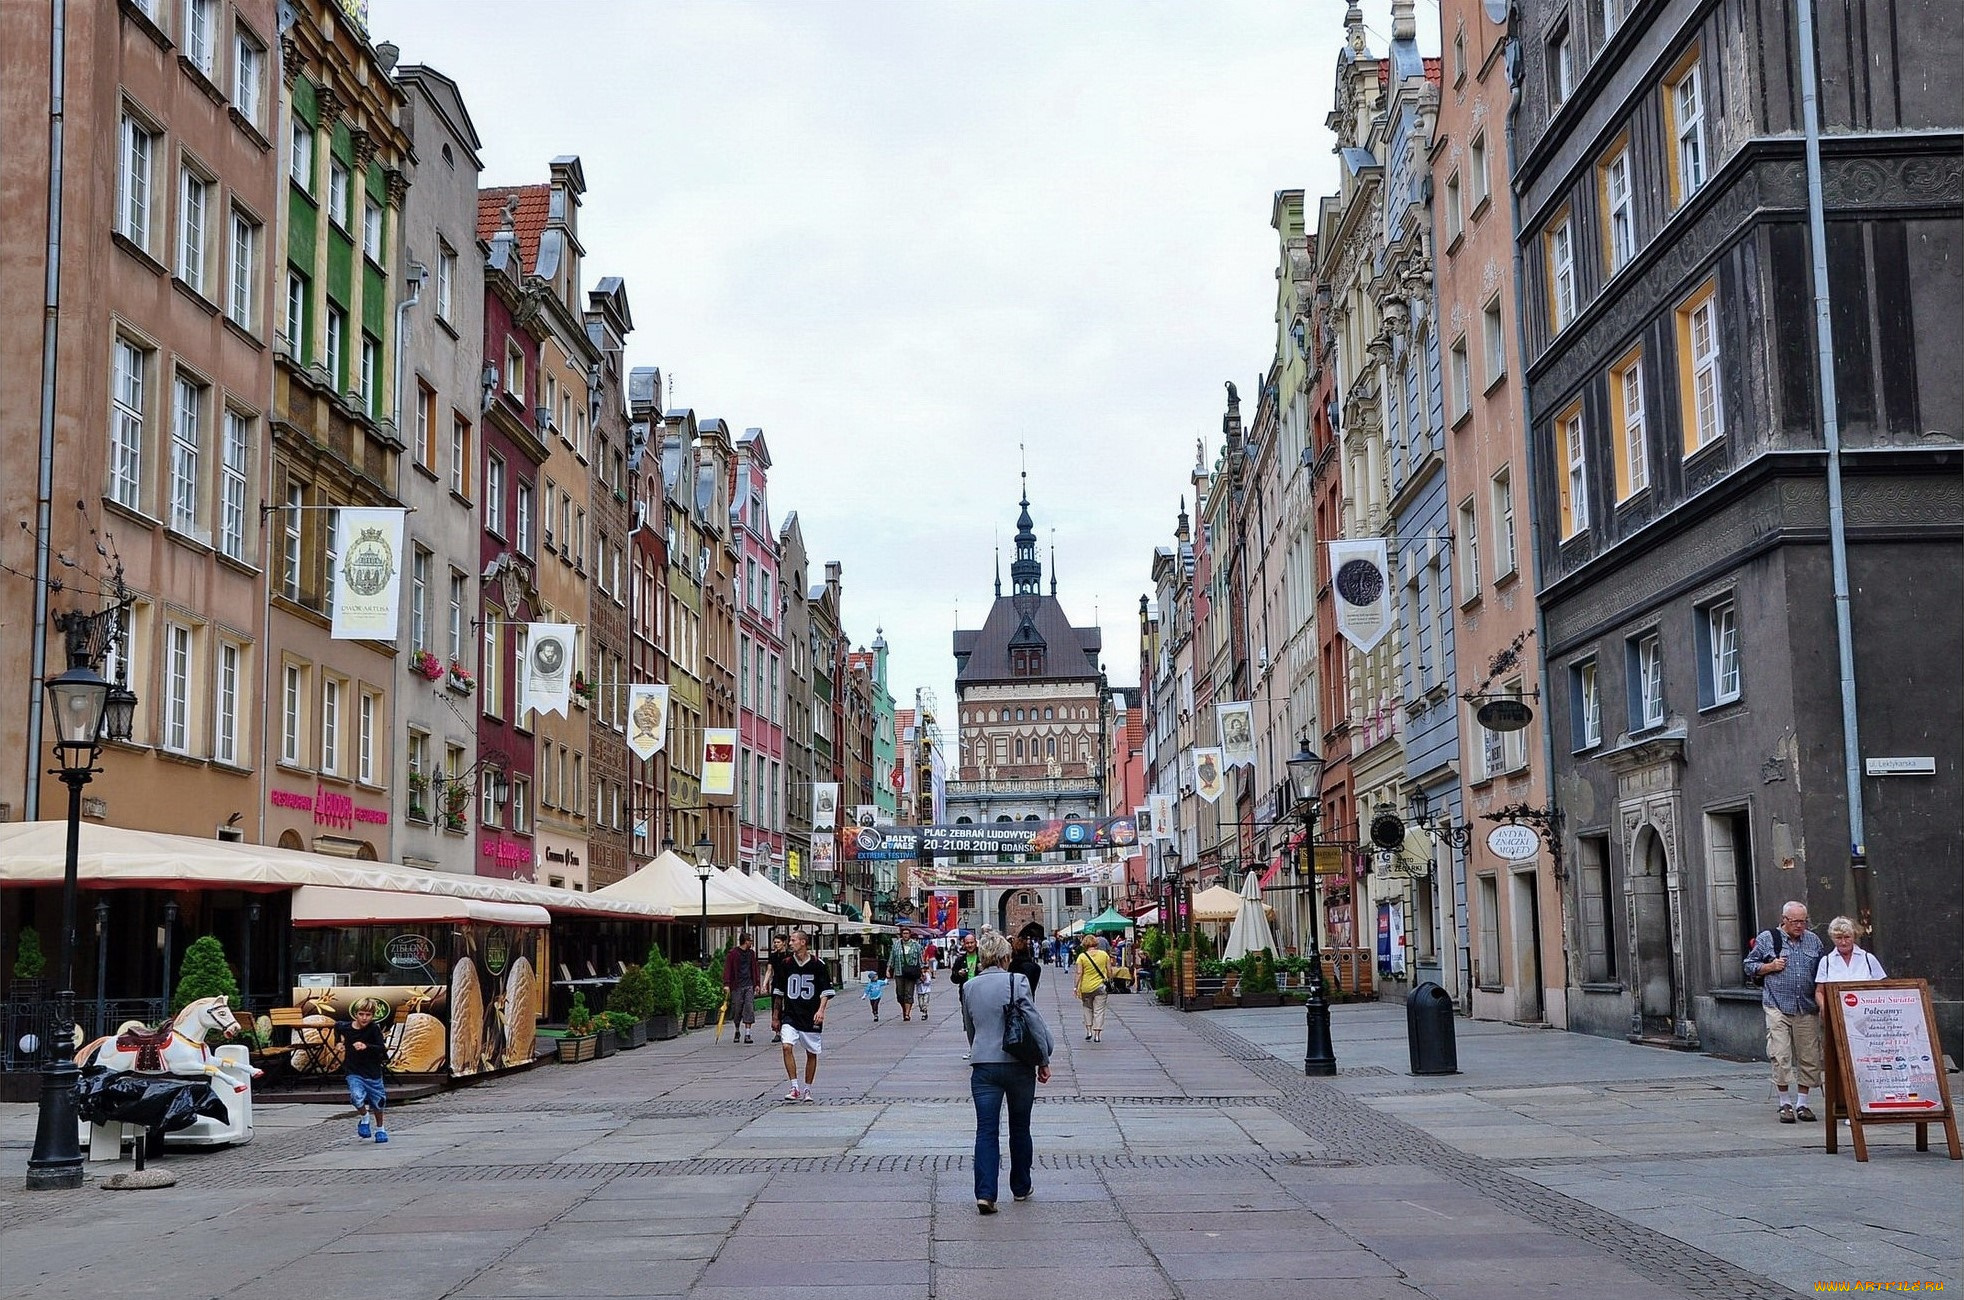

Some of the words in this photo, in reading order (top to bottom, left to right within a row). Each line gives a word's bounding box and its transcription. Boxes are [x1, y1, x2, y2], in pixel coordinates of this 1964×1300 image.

[924, 828, 947, 837] PLAC
[950, 828, 984, 838] ZEBRAŃ
[986, 830, 1036, 839] LUDOWYCH
[1496, 830, 1528, 838] ANTYKI
[924, 839, 999, 852] 20-21.08.2010
[1001, 843, 1036, 852] GDAŃSK
[1495, 838, 1529, 846] ZNACZKI
[888, 851, 917, 859] FESTIVAL
[390, 943, 429, 953] ZIELONA
[787, 973, 815, 1000] 05
[1864, 1007, 1903, 1016] Polecamy:
